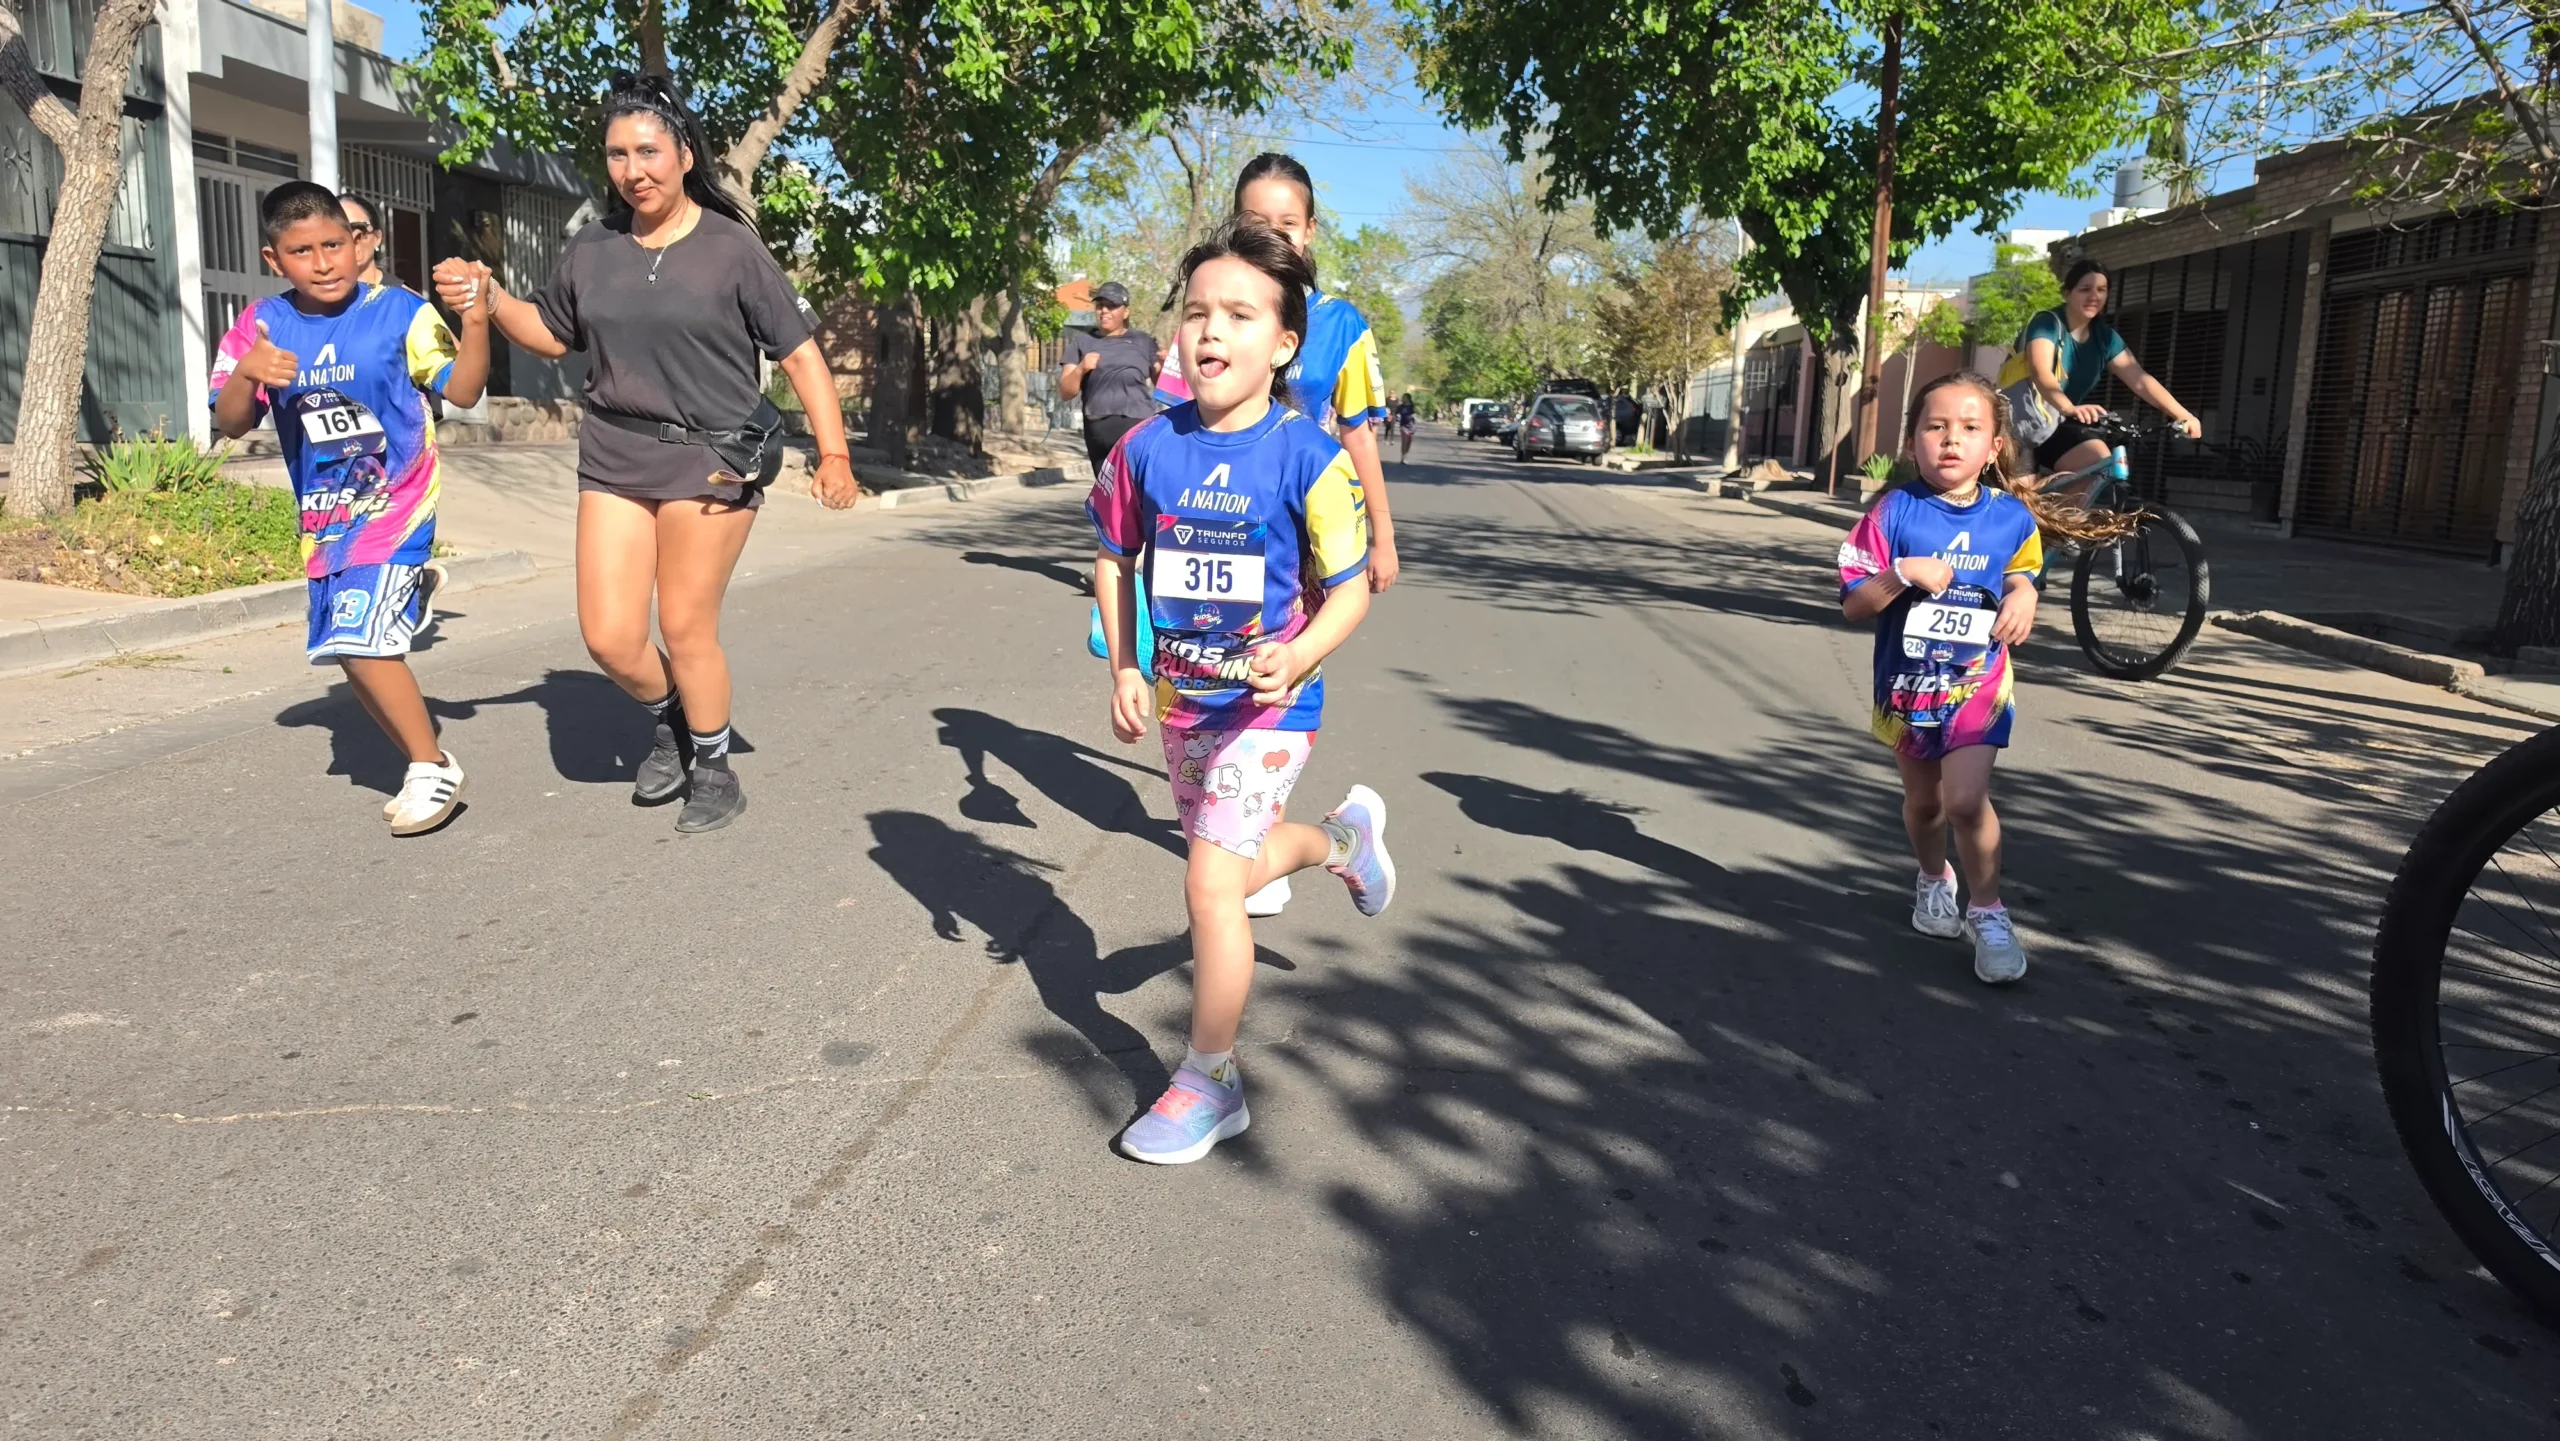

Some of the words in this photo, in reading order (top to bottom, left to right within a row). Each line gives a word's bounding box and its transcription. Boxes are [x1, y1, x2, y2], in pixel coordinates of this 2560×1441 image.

[298, 370, 307, 387] A
[317, 409, 361, 436] 161
[301, 487, 357, 511] KIDS
[1177, 488, 1190, 507] A
[1191, 489, 1252, 515] NATION
[1196, 529, 1247, 540] TRIUNFO
[1197, 537, 1245, 547] SEGUROS
[1941, 551, 1990, 571] NATION
[1184, 557, 1233, 594] 315
[1947, 588, 1987, 600] TRIUNFO
[1947, 595, 1983, 604] SEGUROS
[1928, 608, 1973, 637] 259
[1158, 634, 1226, 665] KIDS
[1905, 640, 1925, 654] 2K
[1153, 652, 1257, 681] RUNNIN
[1892, 673, 1950, 693] KIDS
[2456, 1151, 2551, 1253] FAST
